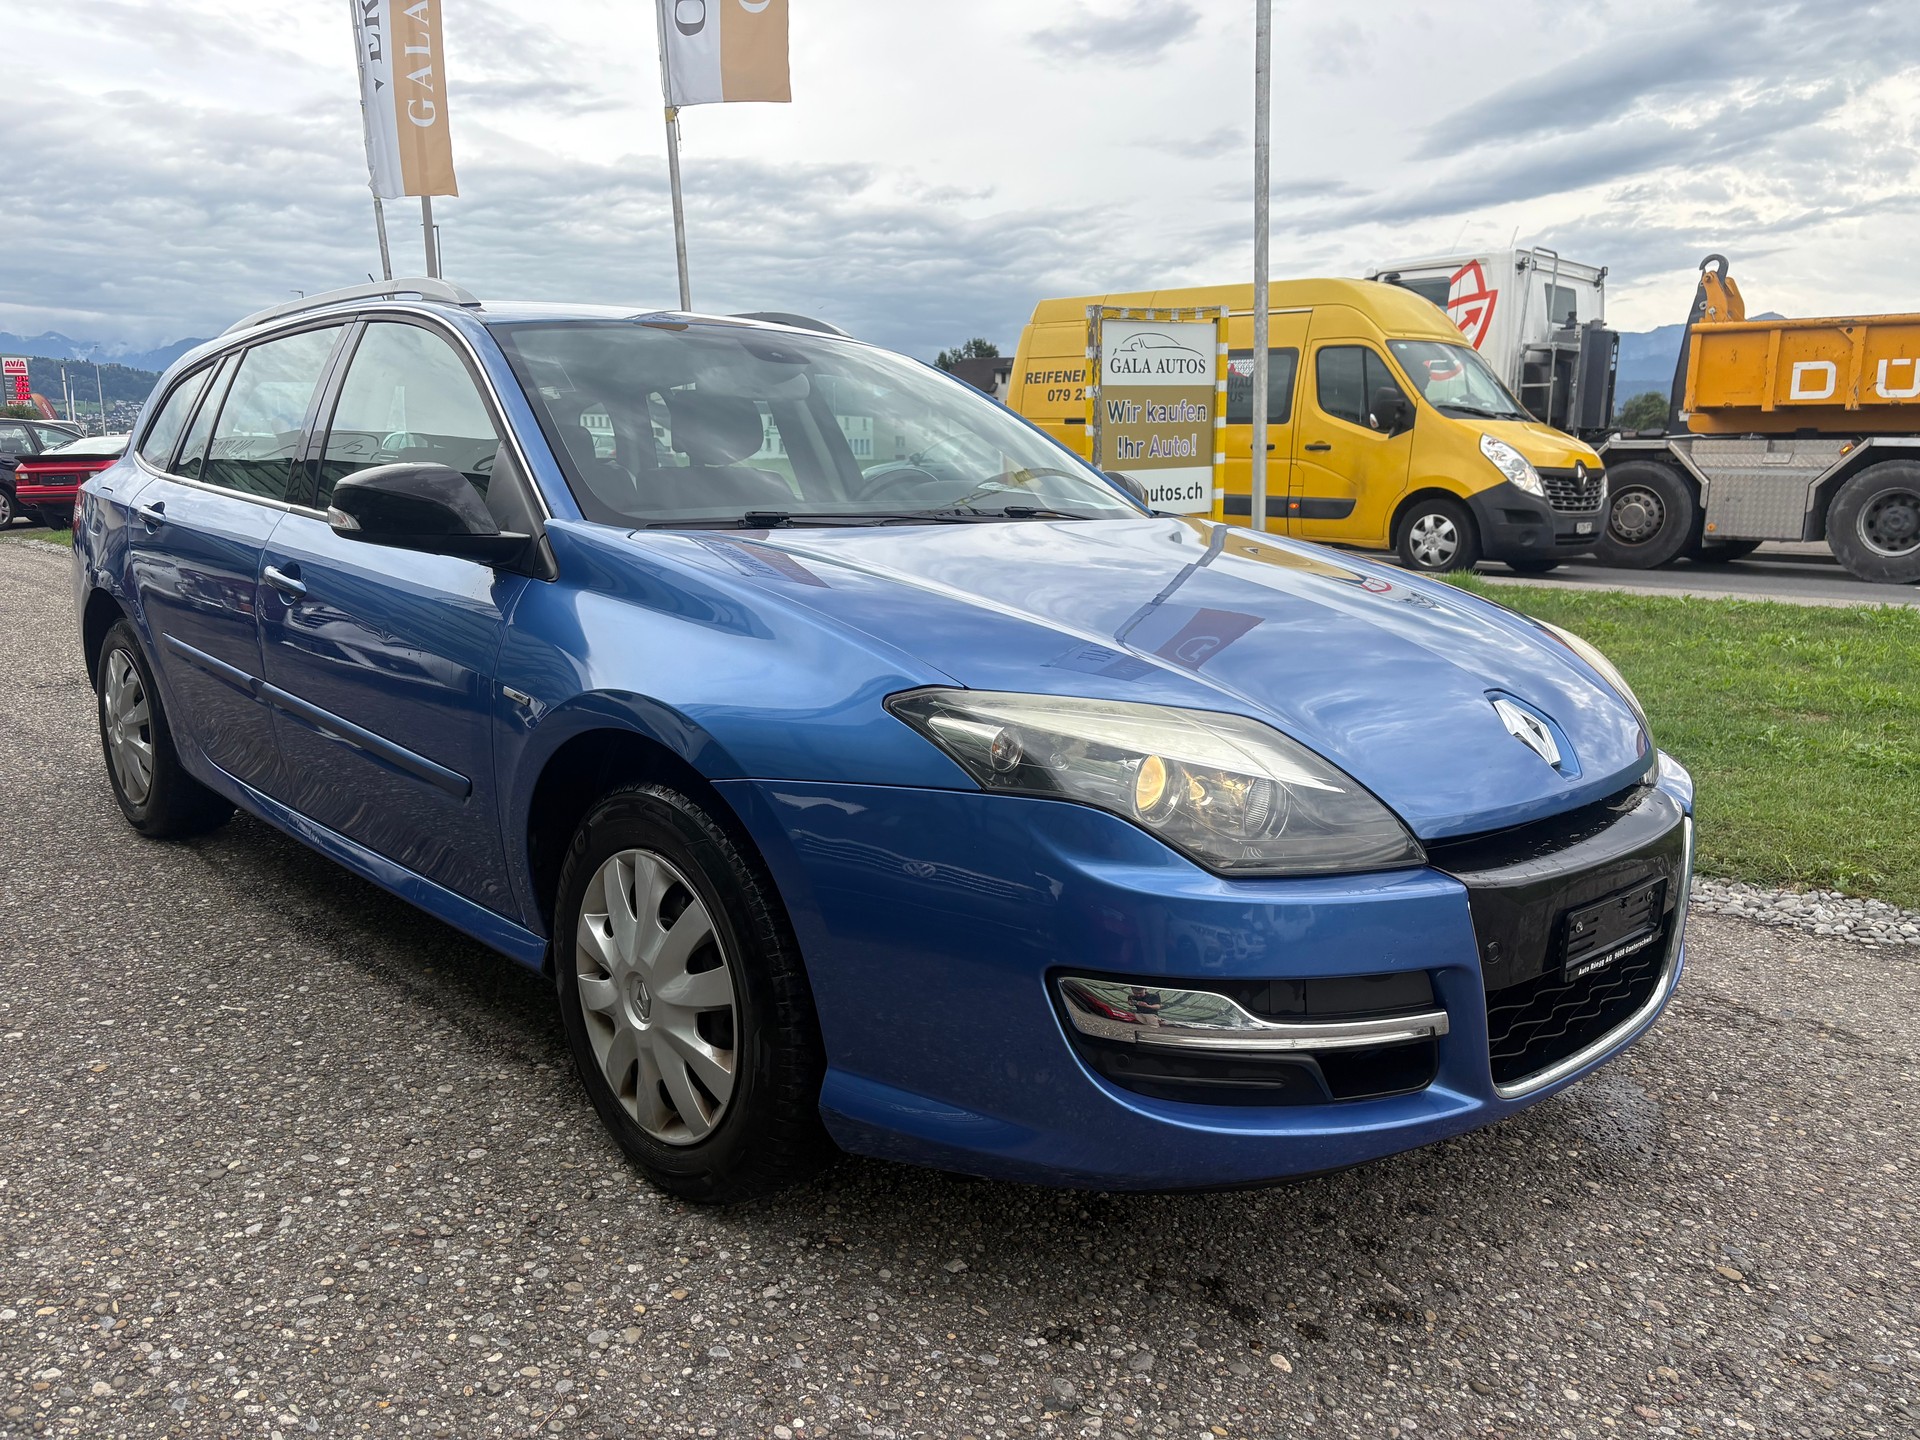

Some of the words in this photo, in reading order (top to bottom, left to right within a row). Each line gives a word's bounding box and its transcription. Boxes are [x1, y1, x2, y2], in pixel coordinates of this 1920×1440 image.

[403, 0, 436, 127] GALA
[1110, 358, 1152, 374] GALA
[1156, 358, 1206, 374] AUTOS
[1047, 388, 1071, 402] 079
[1106, 399, 1142, 424] Wir
[1145, 398, 1207, 423] kaufen
[1117, 435, 1145, 460] Ihr
[1147, 433, 1197, 458] Auto!
[1146, 481, 1203, 502] utos.ch
